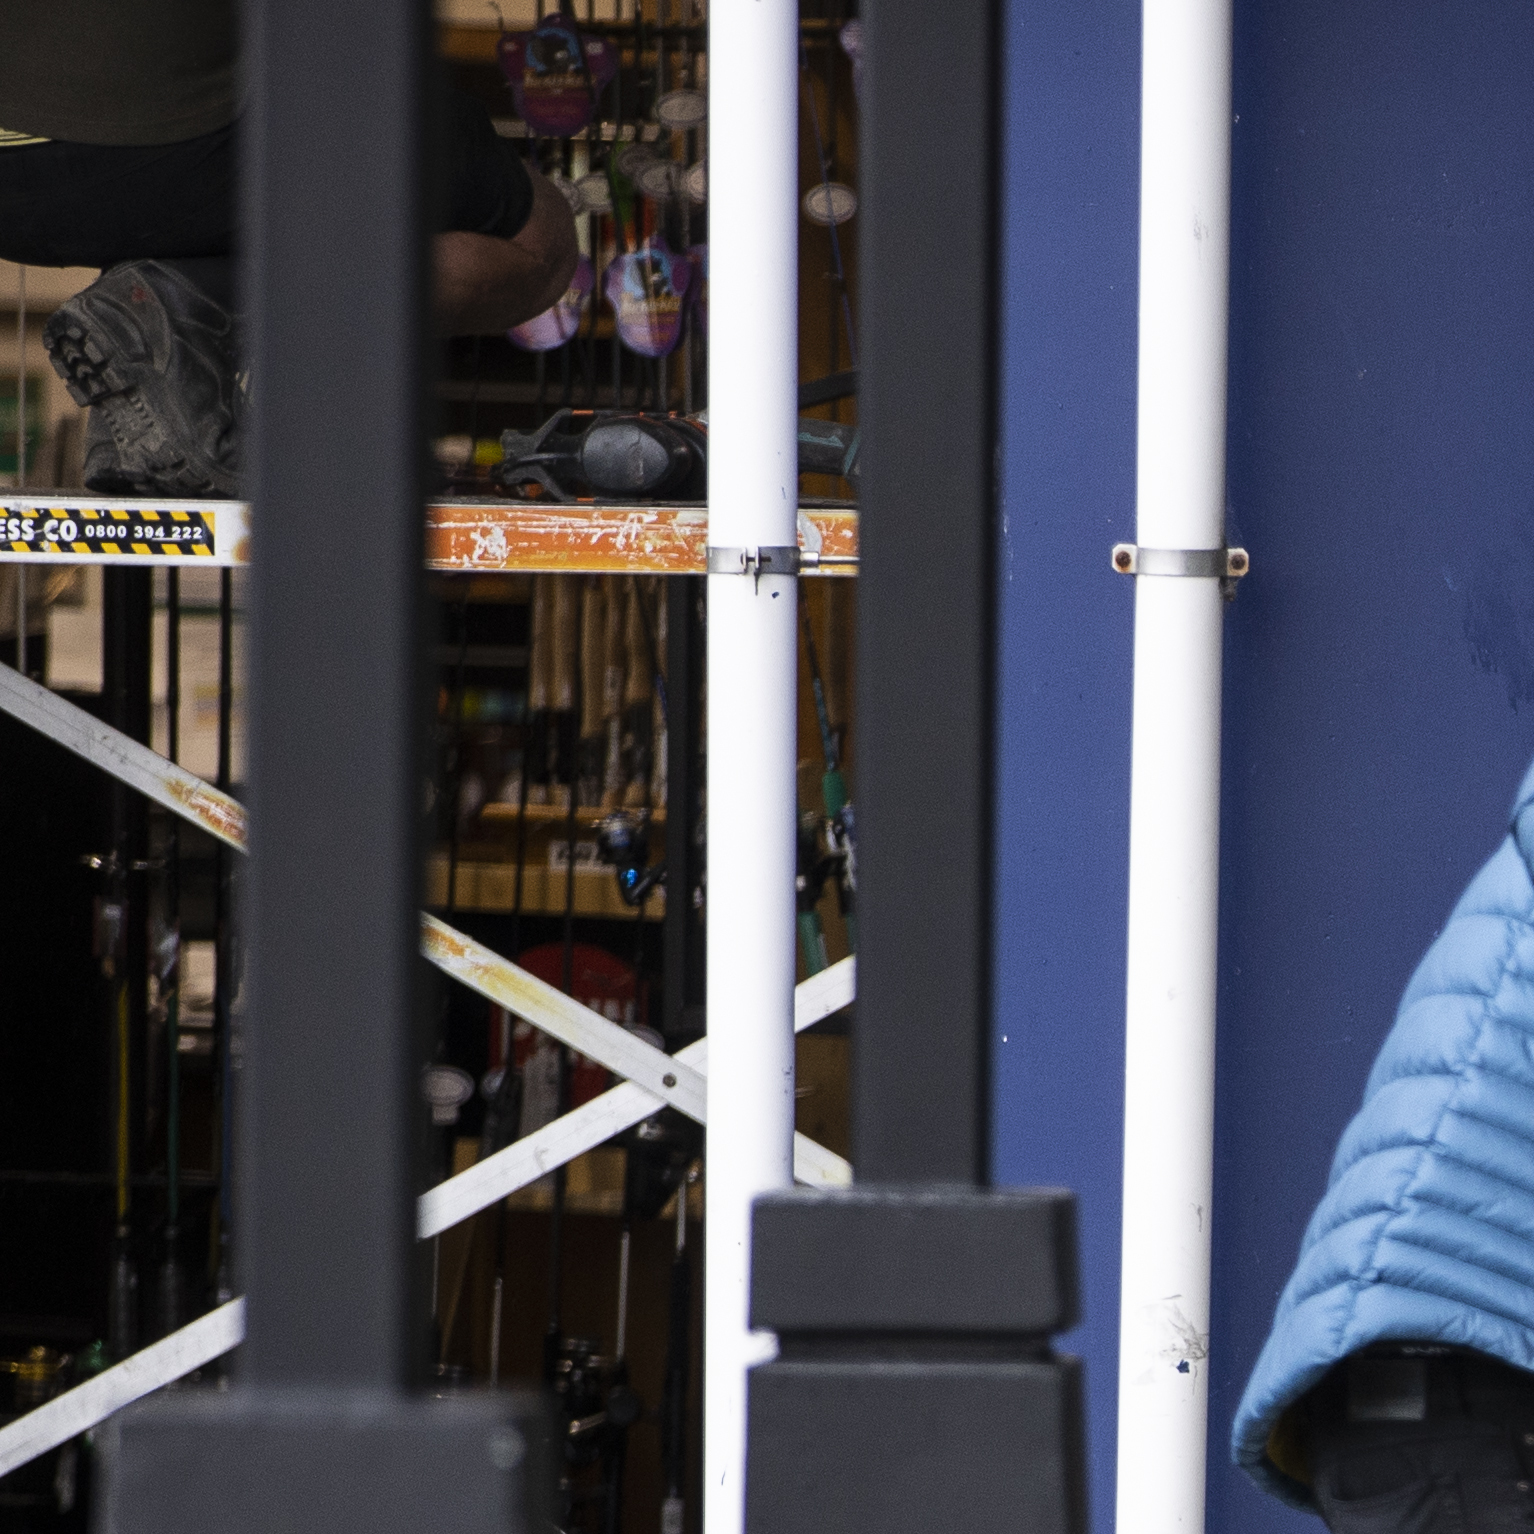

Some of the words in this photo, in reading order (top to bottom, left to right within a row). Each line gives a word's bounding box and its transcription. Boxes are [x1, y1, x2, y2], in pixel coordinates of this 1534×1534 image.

[43, 518, 78, 542] CO
[84, 524, 127, 539] 0800
[133, 525, 165, 540] 394
[171, 526, 203, 540] 222
